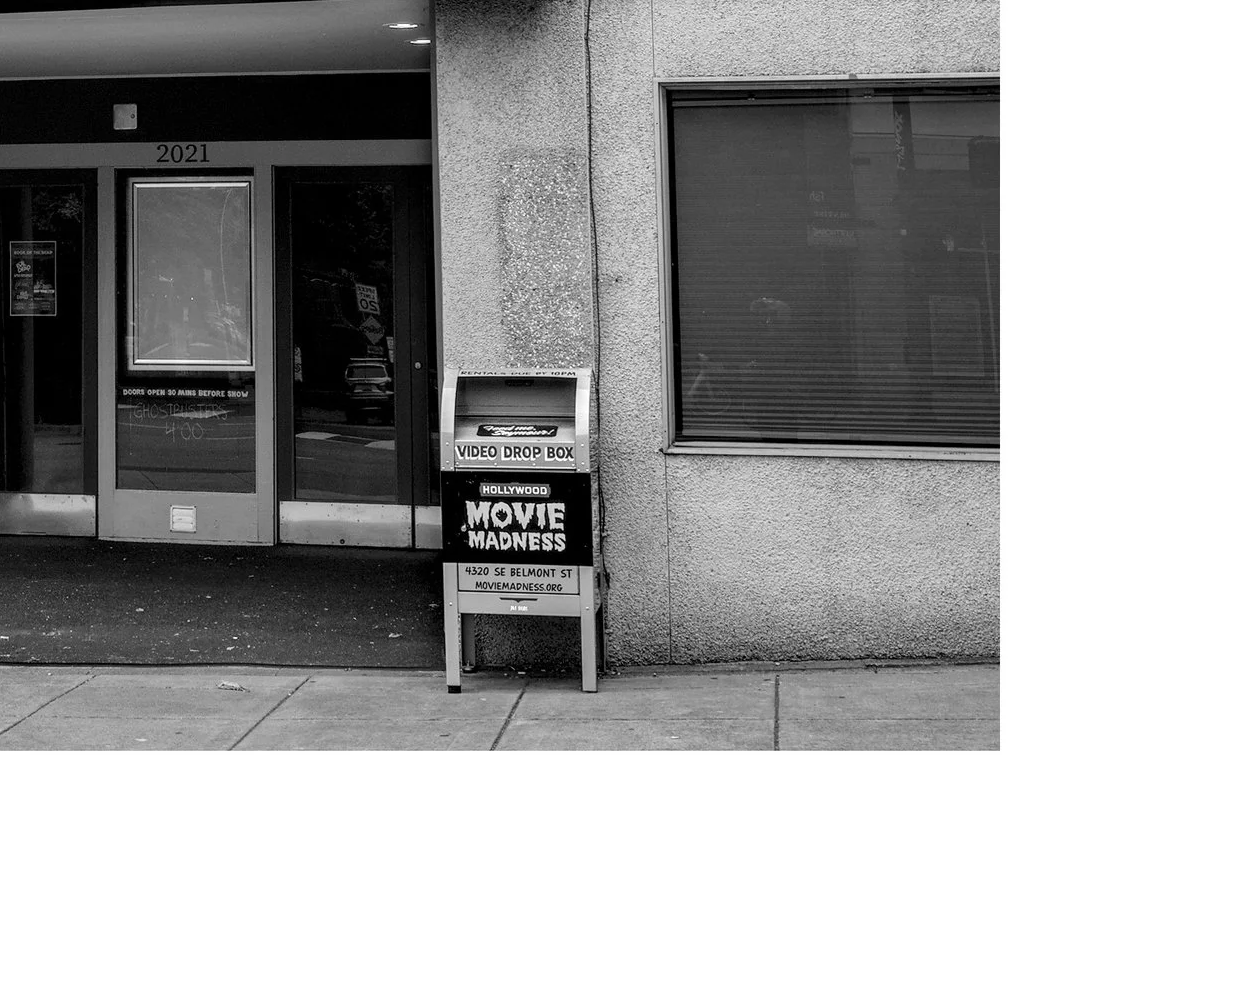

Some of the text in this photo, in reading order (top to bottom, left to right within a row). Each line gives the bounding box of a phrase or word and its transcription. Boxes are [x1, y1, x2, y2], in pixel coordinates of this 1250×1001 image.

[156, 143, 211, 164] 2021
[198, 389, 225, 397] BEFORE
[227, 390, 249, 398] SHOW
[455, 445, 574, 462] VIDEO DROP BOX
[482, 485, 548, 495] HOLLYWOOD
[466, 501, 565, 531] MOVIE
[468, 532, 566, 552] MADNESS
[465, 566, 573, 578] 4320 SE BELMONT ST
[475, 581, 563, 592] MOVIEMADNESS.ORG
